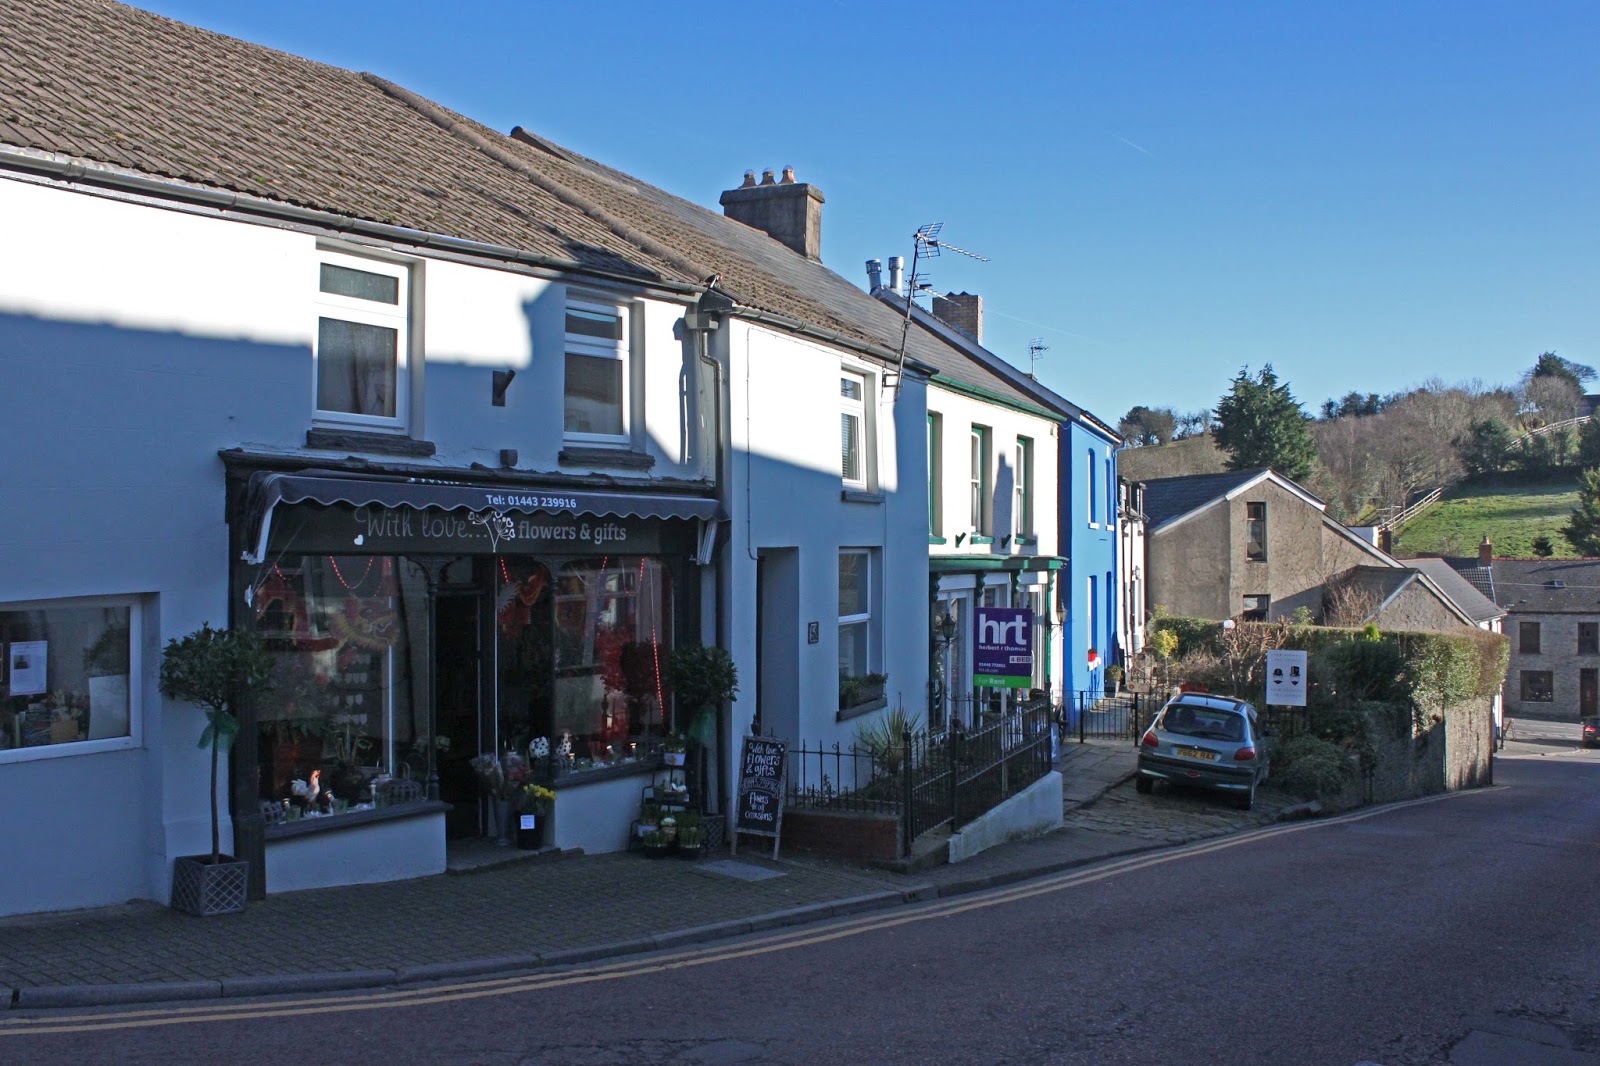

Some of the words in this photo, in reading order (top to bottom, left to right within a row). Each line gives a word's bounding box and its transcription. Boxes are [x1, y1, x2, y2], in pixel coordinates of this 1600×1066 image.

[485, 494, 506, 506] Tel:
[507, 495, 539, 507] 01443
[540, 497, 577, 509] 239916
[353, 506, 414, 538] With
[518, 520, 577, 540] flowers
[579, 522, 592, 540] &
[594, 522, 627, 545] gifts
[979, 613, 1027, 645] hrt
[989, 677, 1005, 685] Rent
[754, 764, 776, 777] gifts
